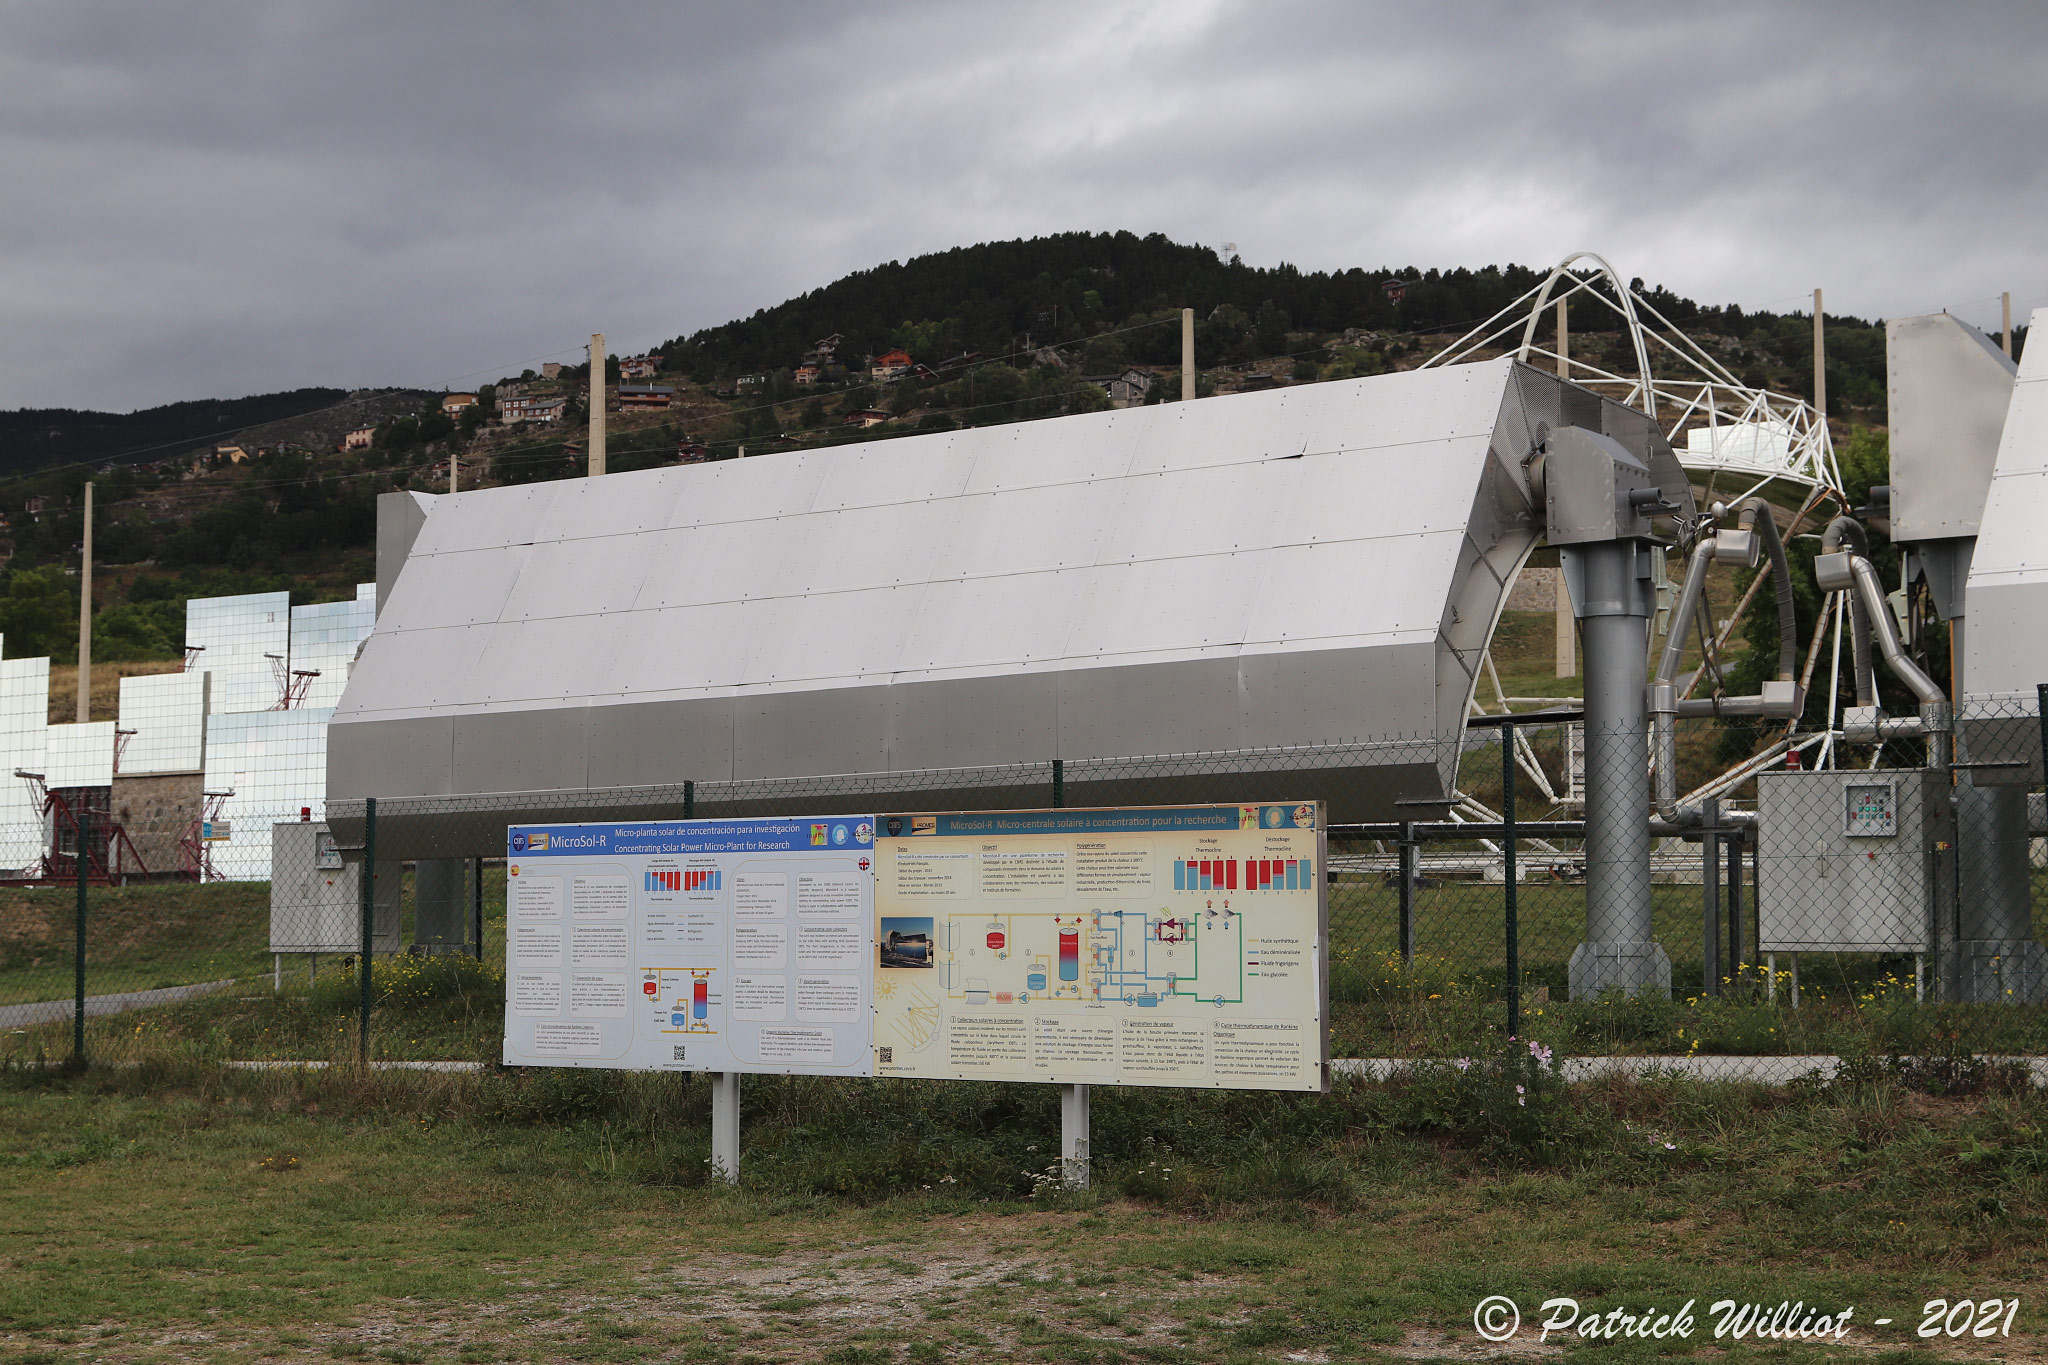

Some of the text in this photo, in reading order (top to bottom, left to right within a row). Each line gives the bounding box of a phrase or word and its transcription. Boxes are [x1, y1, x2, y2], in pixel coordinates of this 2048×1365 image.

[951, 815, 1226, 830] MicroSol-R Micro-centrale solaire à concentration pour la recherche
[615, 824, 800, 838] Micro-planta solar de concentración para investigación
[551, 834, 606, 848] MicroSol-R
[615, 840, 790, 854] Concentrating Solar Power Micro-Plant for Research
